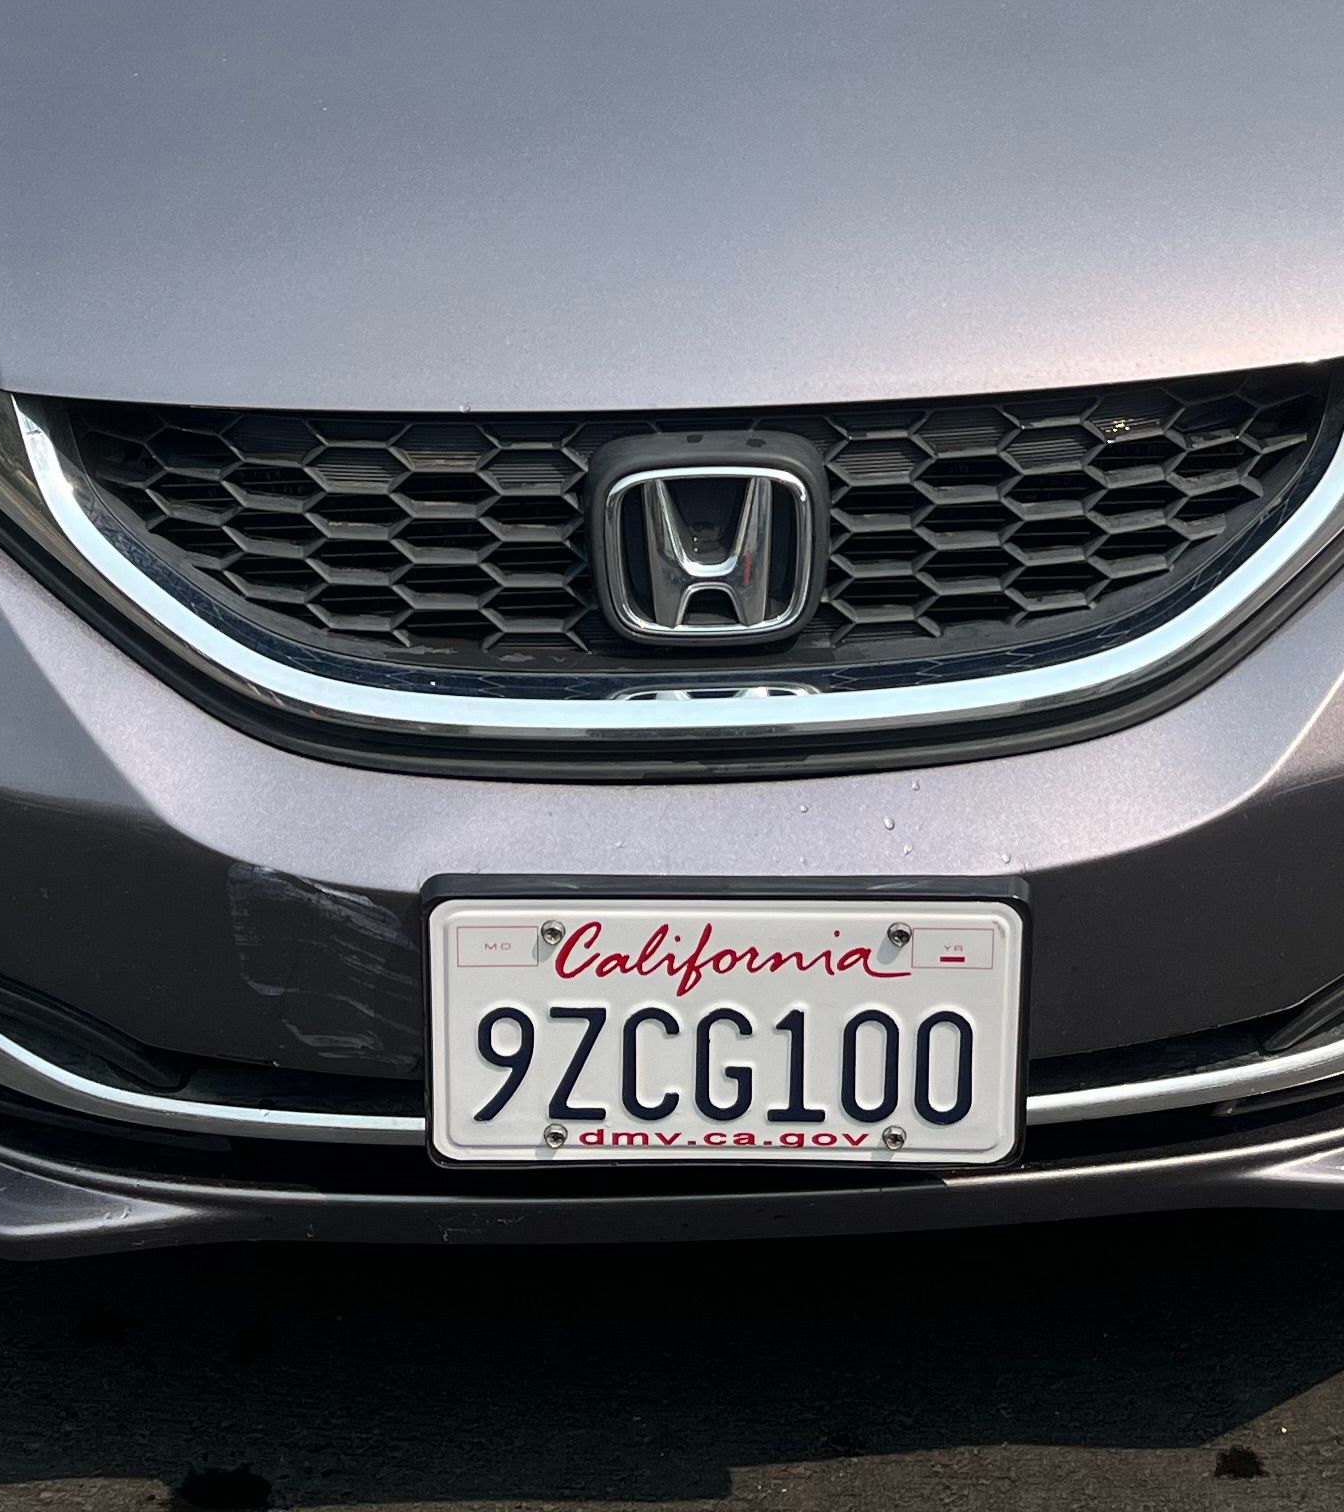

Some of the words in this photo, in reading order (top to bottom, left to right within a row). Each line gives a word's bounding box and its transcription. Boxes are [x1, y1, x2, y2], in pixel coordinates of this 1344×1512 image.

[554, 920, 912, 997] California
[473, 1006, 973, 1125] 9ZCG100
[578, 1128, 870, 1149] dmv.ca.gov
